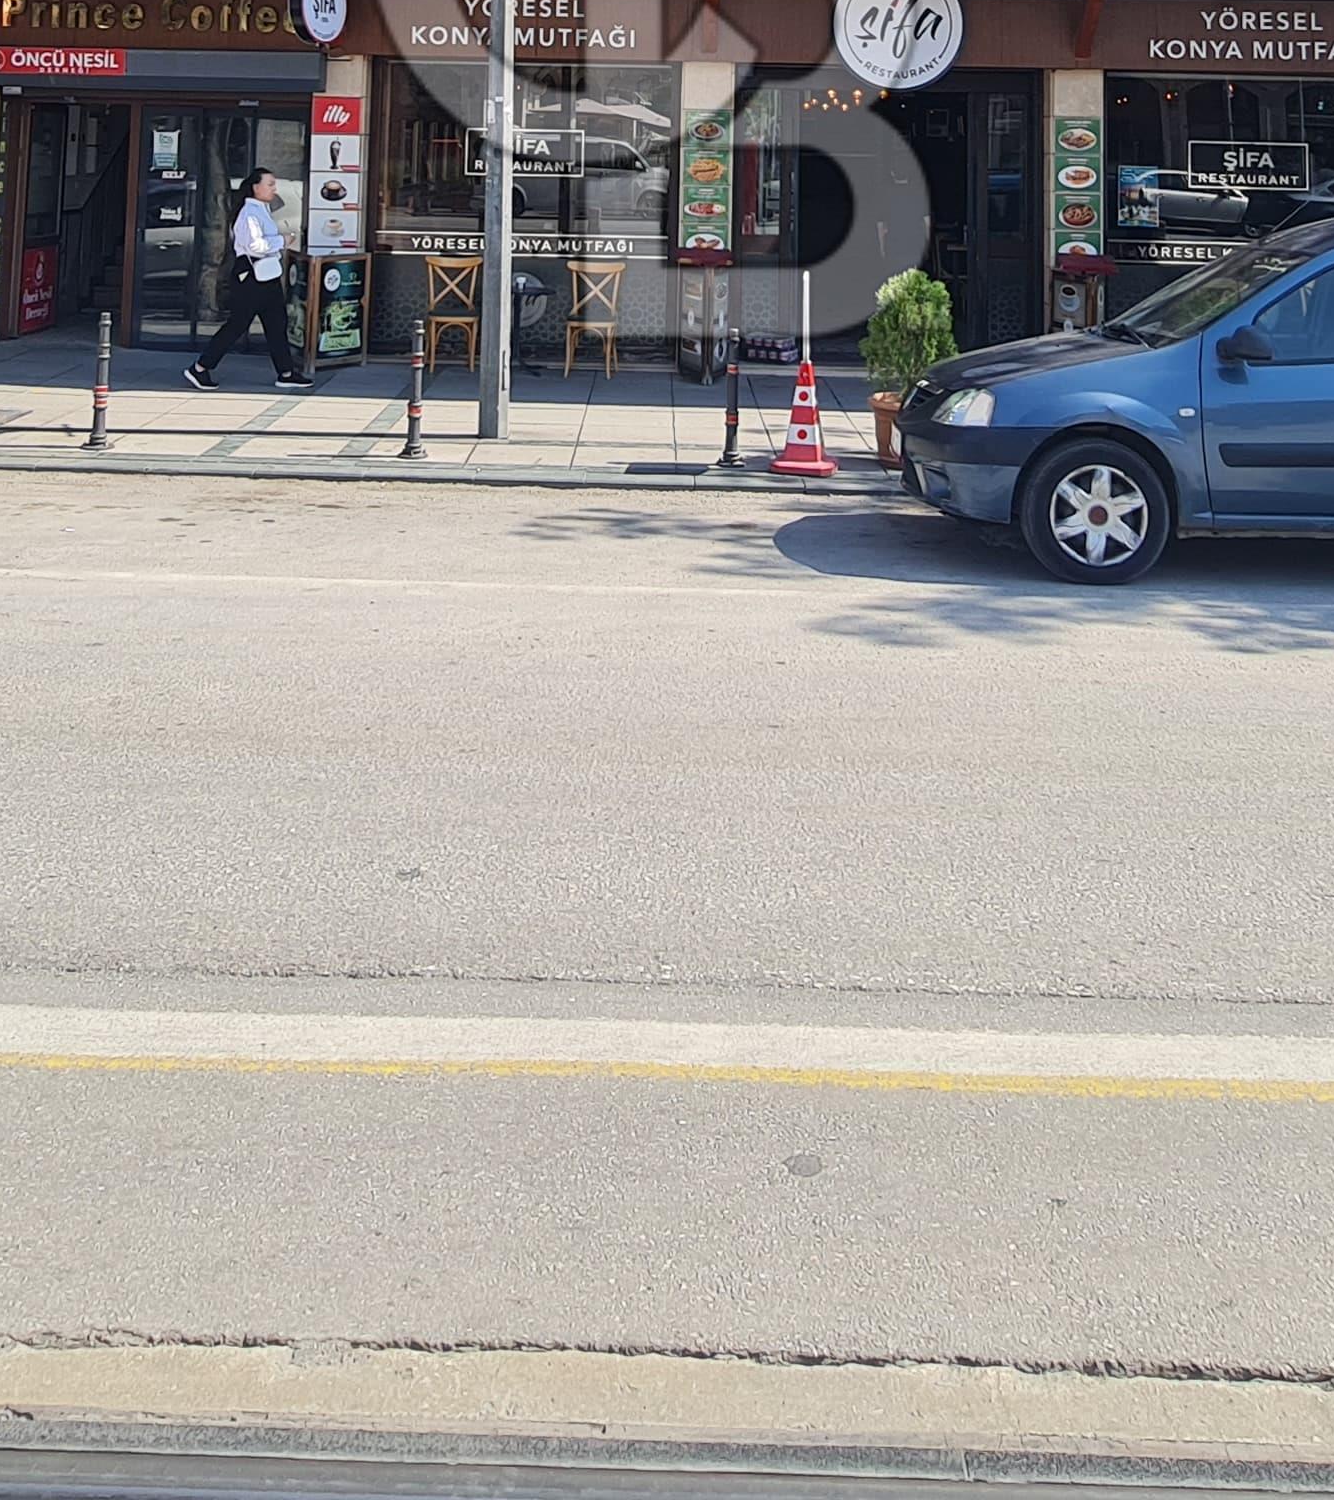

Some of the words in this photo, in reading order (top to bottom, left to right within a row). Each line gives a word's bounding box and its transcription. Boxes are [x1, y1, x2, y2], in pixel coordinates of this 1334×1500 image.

[1200, 6, 1324, 32] YÖRESEL
[411, 25, 493, 46] KONY
[514, 24, 636, 48] MUTFAĞI
[10, 49, 65, 67] ÖNCÜ
[69, 50, 119, 68] NESİL
[1149, 39, 1244, 61] KONYA
[862, 56, 941, 80] RESTAURANT
[322, 104, 351, 128] illy
[515, 133, 552, 156] İFA
[474, 159, 574, 174] RAURANT
[1222, 147, 1276, 172] ŞİFA
[1197, 173, 1300, 186] RESTAURANT
[510, 238, 550, 252] ONYA
[557, 239, 634, 253] MUTFAĞI
[1137, 243, 1217, 260] YÖRESEL
